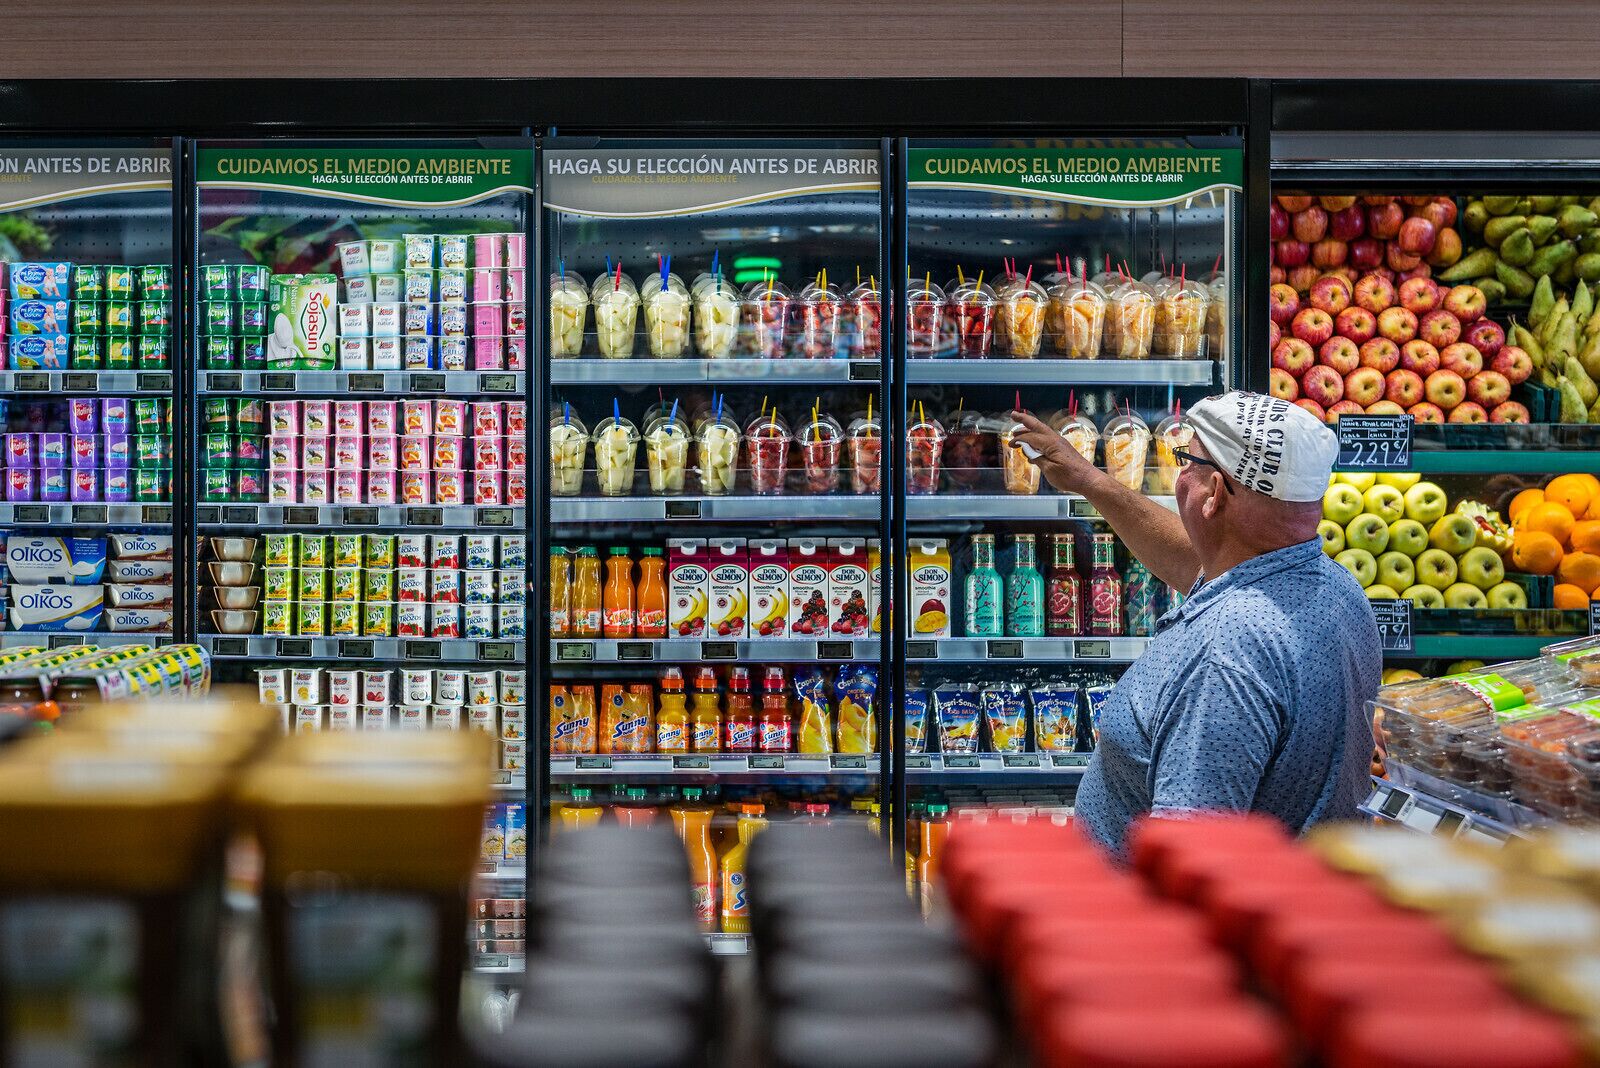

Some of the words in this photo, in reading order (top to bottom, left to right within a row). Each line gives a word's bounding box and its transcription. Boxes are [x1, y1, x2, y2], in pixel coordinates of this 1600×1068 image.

[24, 158, 82, 173] ANTES
[88, 158, 110, 173] DE
[116, 158, 171, 173] ABRIR
[217, 158, 318, 175] CUIDAMOS
[324, 159, 341, 174] EL
[349, 158, 411, 175] MEDIO
[415, 158, 511, 175] AMBIENTE
[549, 159, 602, 174] HAGA
[607, 159, 630, 174] SU
[637, 154, 716, 174] ELECCIÓN
[729, 158, 788, 174] ANTES
[795, 159, 817, 173] DE
[822, 159, 878, 174] ABRIR
[925, 158, 1028, 175] CUIDAMOS
[1033, 158, 1052, 173] EL
[1057, 158, 1120, 174] MEDIO
[1125, 157, 1221, 173] AMBIENTE
[312, 175, 338, 184] HAGA
[341, 175, 353, 184] SU
[355, 173, 398, 184] ELECCIÓN
[400, 175, 426, 184] ANTES
[429, 175, 443, 184] DE
[446, 175, 473, 184] ABRIR
[592, 175, 642, 184] CUIDAMOS
[644, 175, 654, 184] EL
[657, 175, 688, 184] MEDIO
[690, 175, 738, 184] AMBIENTE
[1021, 174, 1048, 183] HAGA
[1050, 174, 1062, 183] SU
[1064, 172, 1107, 183] ELECCIÓN
[1109, 174, 1139, 183] ANTES
[1141, 174, 1153, 183] DE
[1155, 174, 1183, 183] ABRIR
[308, 291, 322, 351] Sojasun
[1261, 429, 1285, 475] CLUB
[553, 716, 590, 739] Sunny
[612, 716, 648, 738] Sunny
[658, 728, 681, 743] Sunny
[732, 727, 756, 744] Sunny
[763, 727, 788, 744] Sunny
